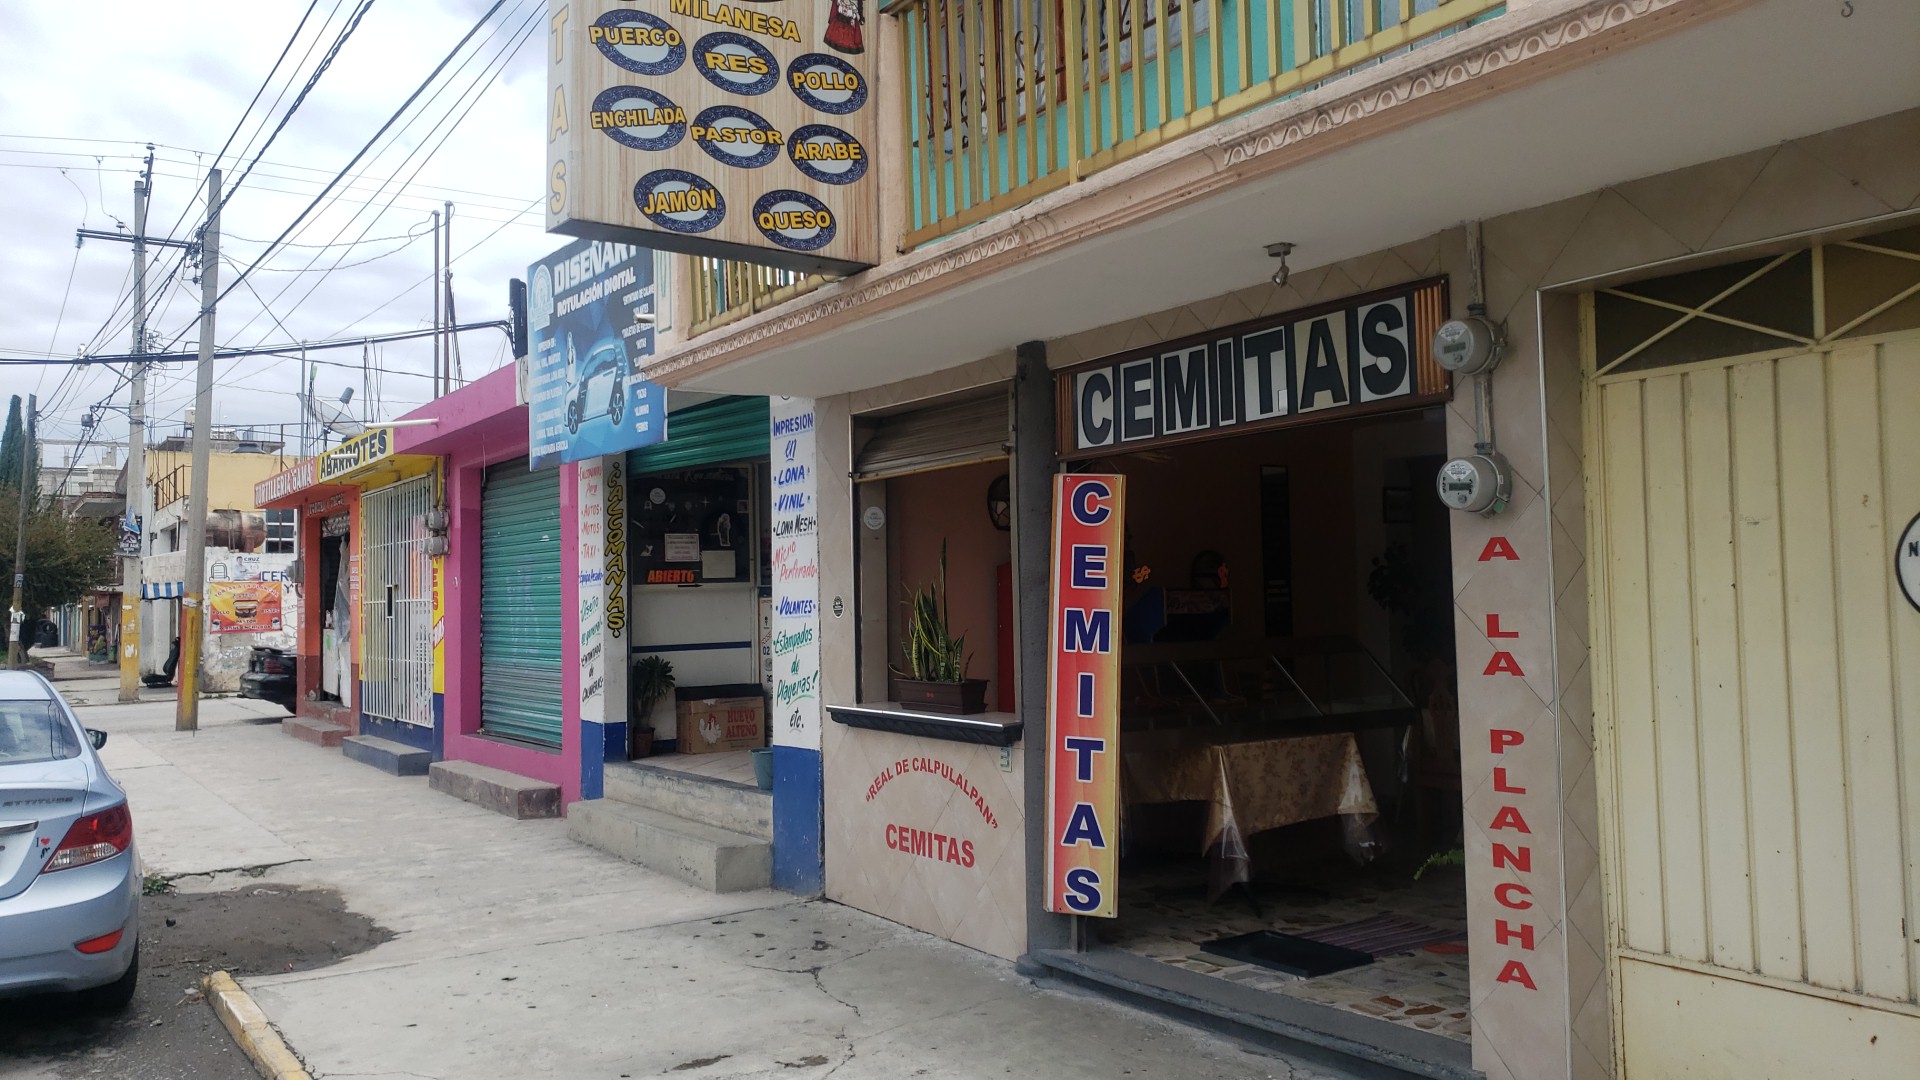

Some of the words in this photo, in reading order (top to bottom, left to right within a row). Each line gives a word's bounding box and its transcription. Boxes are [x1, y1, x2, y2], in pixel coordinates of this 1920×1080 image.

[669, 0, 801, 42] MILANESA
[589, 26, 681, 47] PUERCO
[704, 52, 769, 75] RES
[792, 71, 859, 91] POLLO
[590, 107, 687, 129] ENCHILADA
[690, 125, 784, 145] PASTOR
[793, 139, 862, 161] ÁRABE
[643, 185, 717, 215] JAMÓN
[758, 210, 831, 230] QUESO
[557, 282, 603, 317] ROTULACIÓN
[603, 266, 636, 296] DIGITAL
[1081, 303, 1408, 446] CEMITAS
[320, 429, 387, 479] ABARROTES
[778, 465, 805, 485] LONA
[778, 492, 805, 511] VINIL
[776, 519, 794, 537] LONA
[583, 543, 596, 560] TAXI
[604, 469, 626, 630] CALCOMANIAS
[1478, 536, 1521, 561] A
[647, 569, 696, 583] ABIERTO
[774, 622, 813, 654] Estampados
[1482, 614, 1526, 677] LA
[791, 654, 800, 674] de
[1061, 481, 1113, 912] CEMITAS
[789, 707, 805, 729] etc.
[895, 759, 910, 776] DE
[886, 823, 976, 869] CEMITAS
[1489, 729, 1538, 991] PLANCHA
